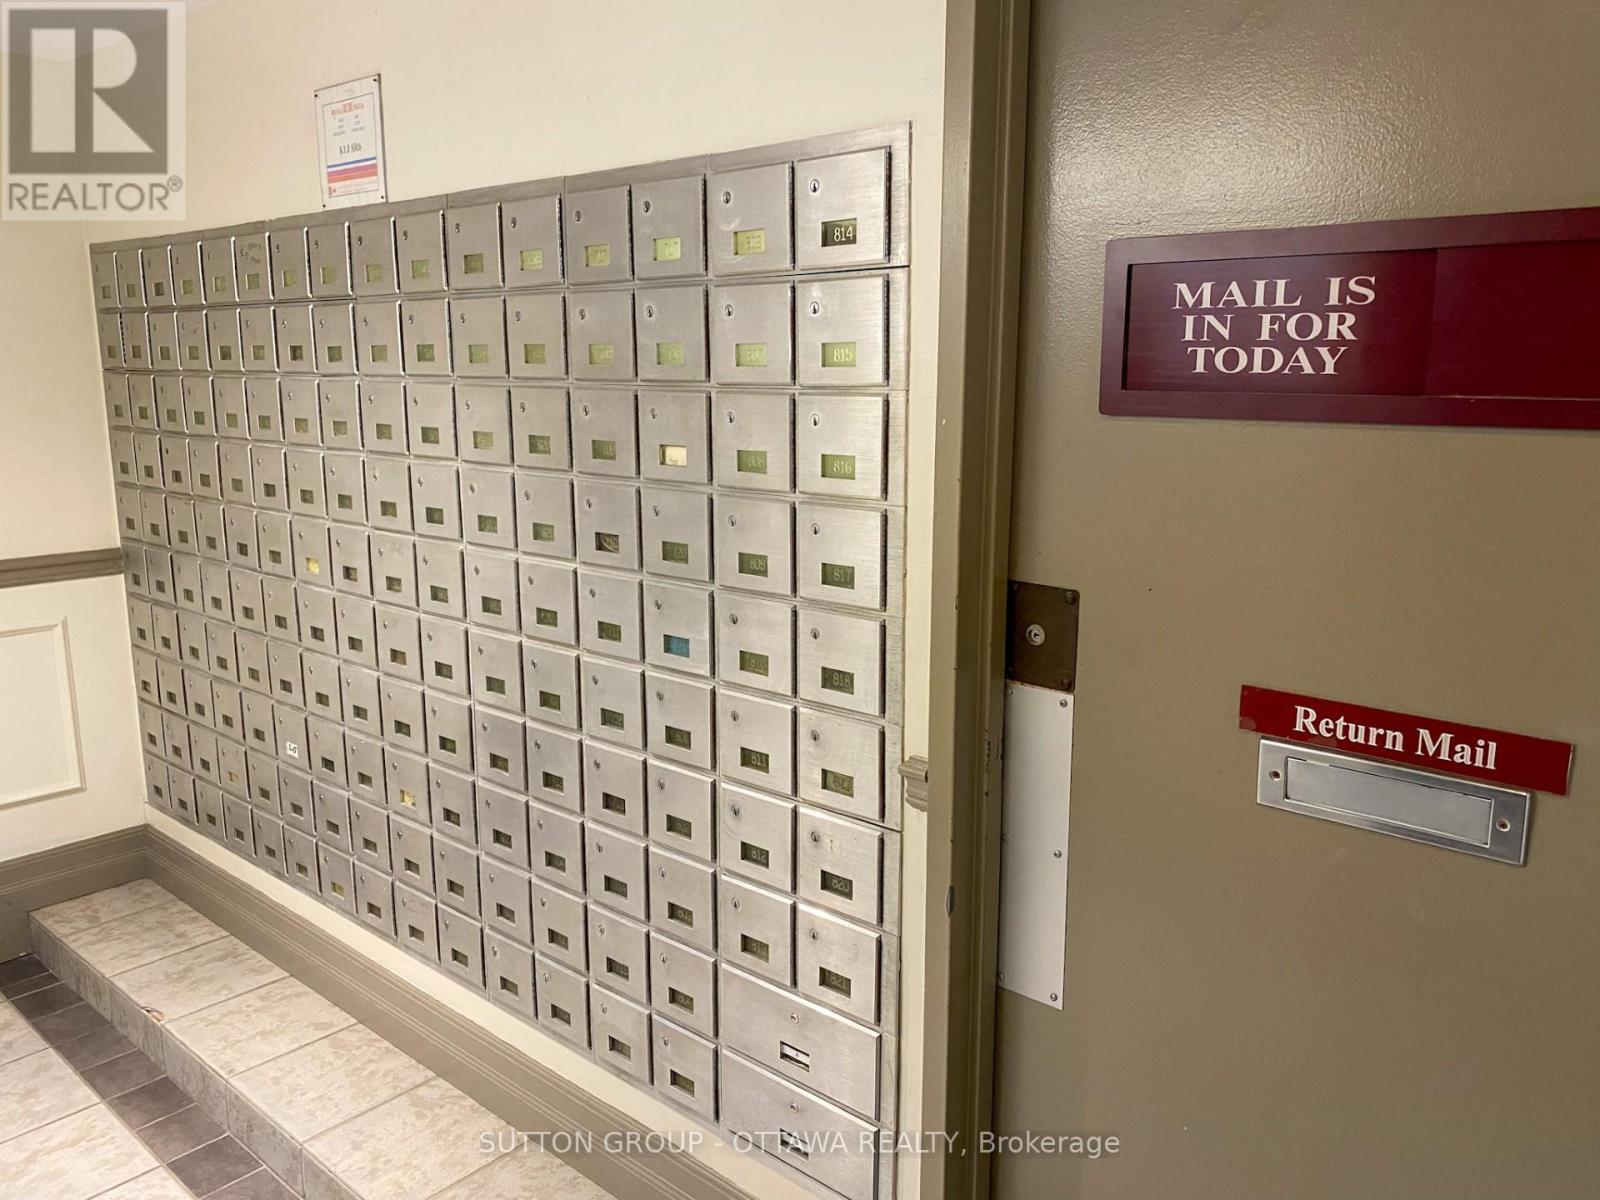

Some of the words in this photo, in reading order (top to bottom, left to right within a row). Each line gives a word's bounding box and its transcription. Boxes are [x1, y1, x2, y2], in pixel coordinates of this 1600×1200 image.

[833, 225, 853, 242] 814
[1172, 279, 1302, 309] MAIL
[1324, 276, 1376, 306] IS
[1181, 314, 1235, 341] IN
[1256, 312, 1358, 341] FOR
[833, 347, 853, 361] 815
[1187, 346, 1349, 375] TODAY
[833, 460, 852, 474] 816
[1292, 705, 1405, 752] Return
[1415, 728, 1497, 770] Mail
